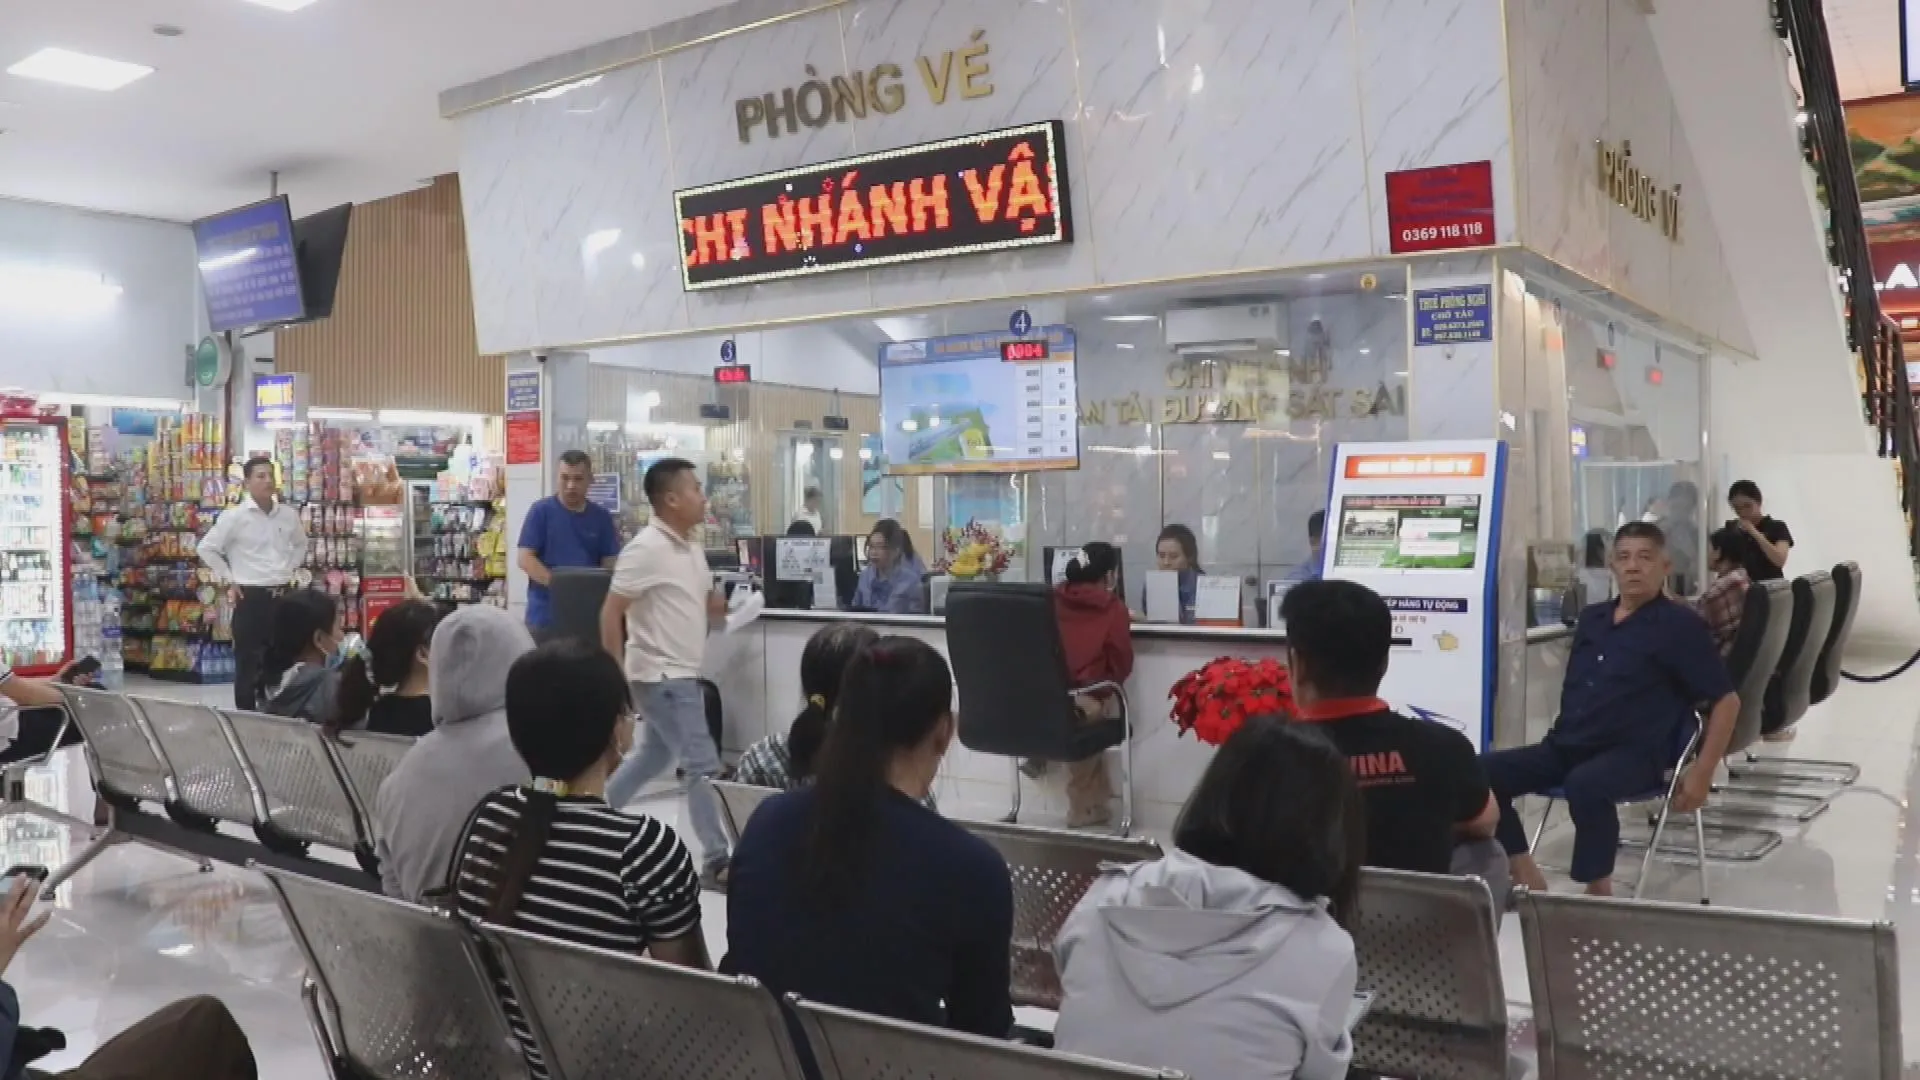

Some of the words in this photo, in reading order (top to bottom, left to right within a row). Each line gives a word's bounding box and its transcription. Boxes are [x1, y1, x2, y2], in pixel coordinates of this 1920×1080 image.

[735, 63, 906, 143] PHÒNG
[915, 29, 995, 105] VÉ
[681, 208, 752, 268] CHI
[761, 170, 950, 255] NHÁNH
[962, 141, 1058, 232] VẬ
[1402, 226, 1437, 242] 0369
[1440, 223, 1460, 239] 118
[1463, 221, 1483, 236] 118
[1014, 313, 1027, 333] 4
[724, 342, 733, 361] 3
[1166, 359, 1213, 388] CHI
[1161, 389, 1277, 424] ĐƯNG
